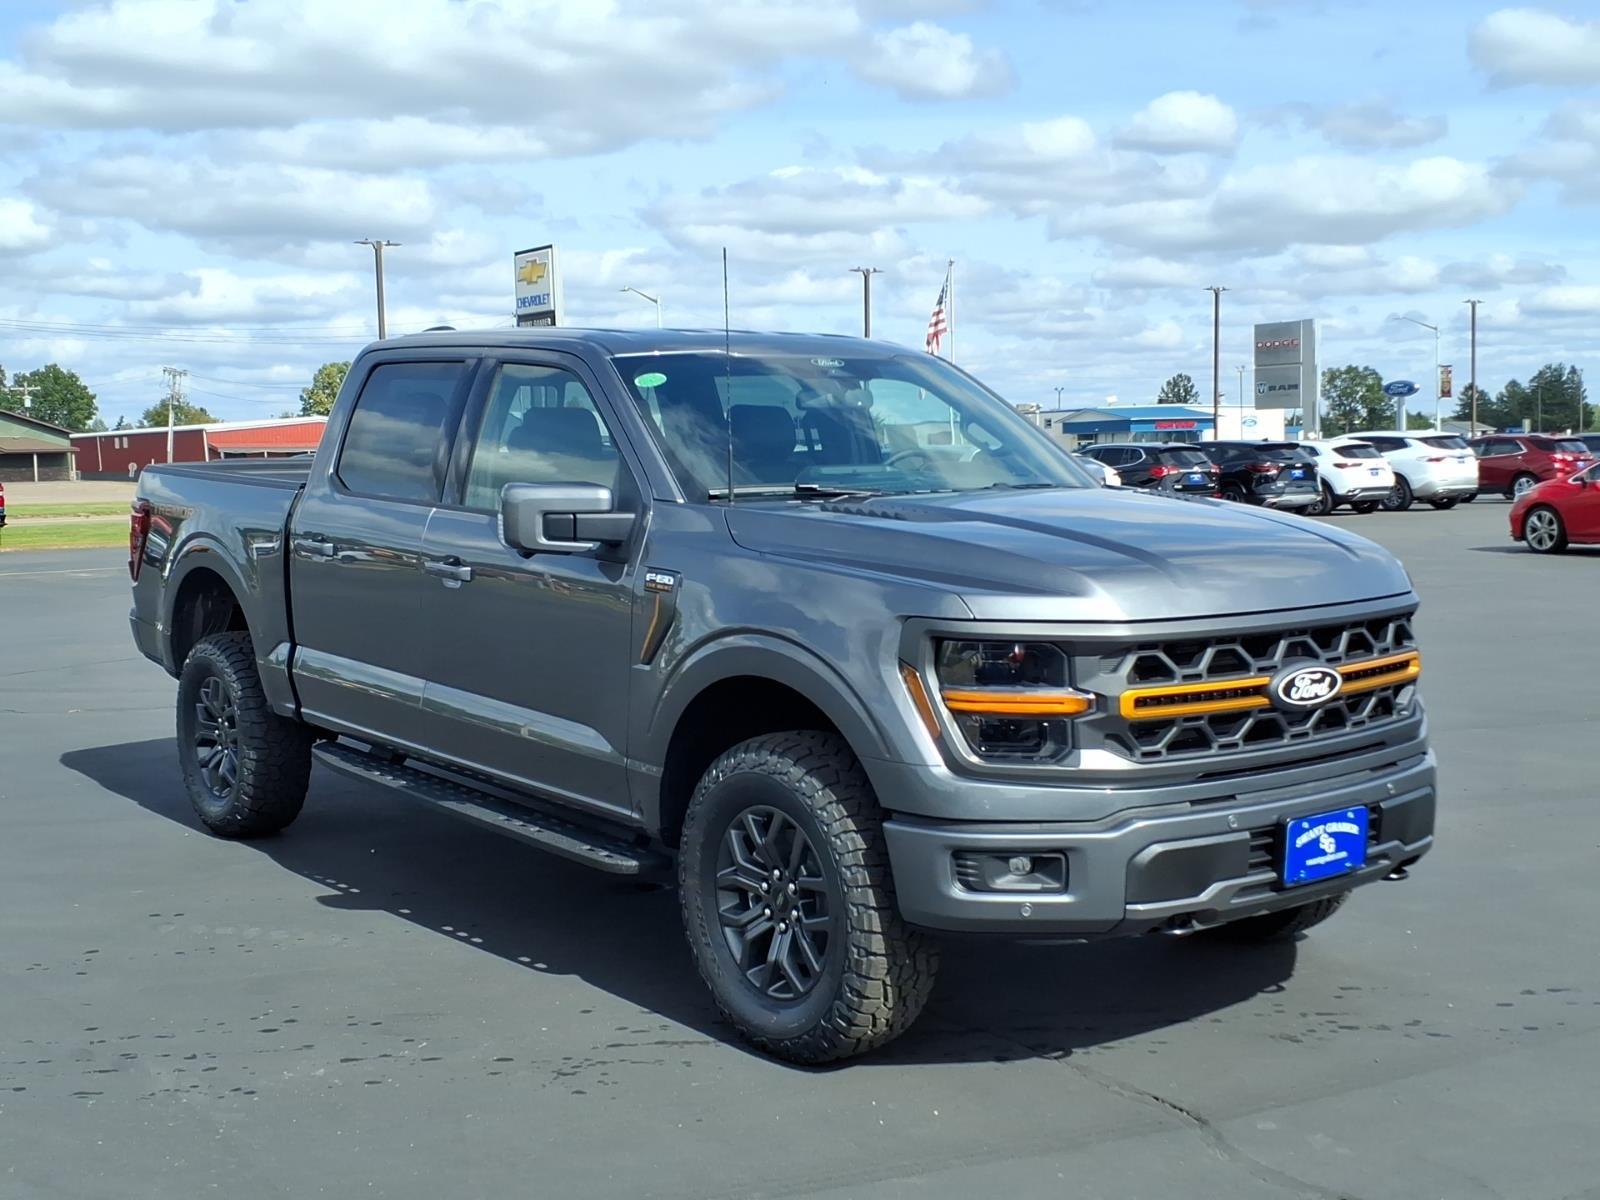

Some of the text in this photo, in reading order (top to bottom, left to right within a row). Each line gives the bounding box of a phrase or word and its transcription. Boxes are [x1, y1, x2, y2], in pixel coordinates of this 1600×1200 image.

[517, 293, 551, 309] CHEVROLET
[1256, 339, 1299, 349] DODGE
[1268, 384, 1299, 392] RAM
[1389, 383, 1409, 394] Ford
[1291, 672, 1331, 700] Ford
